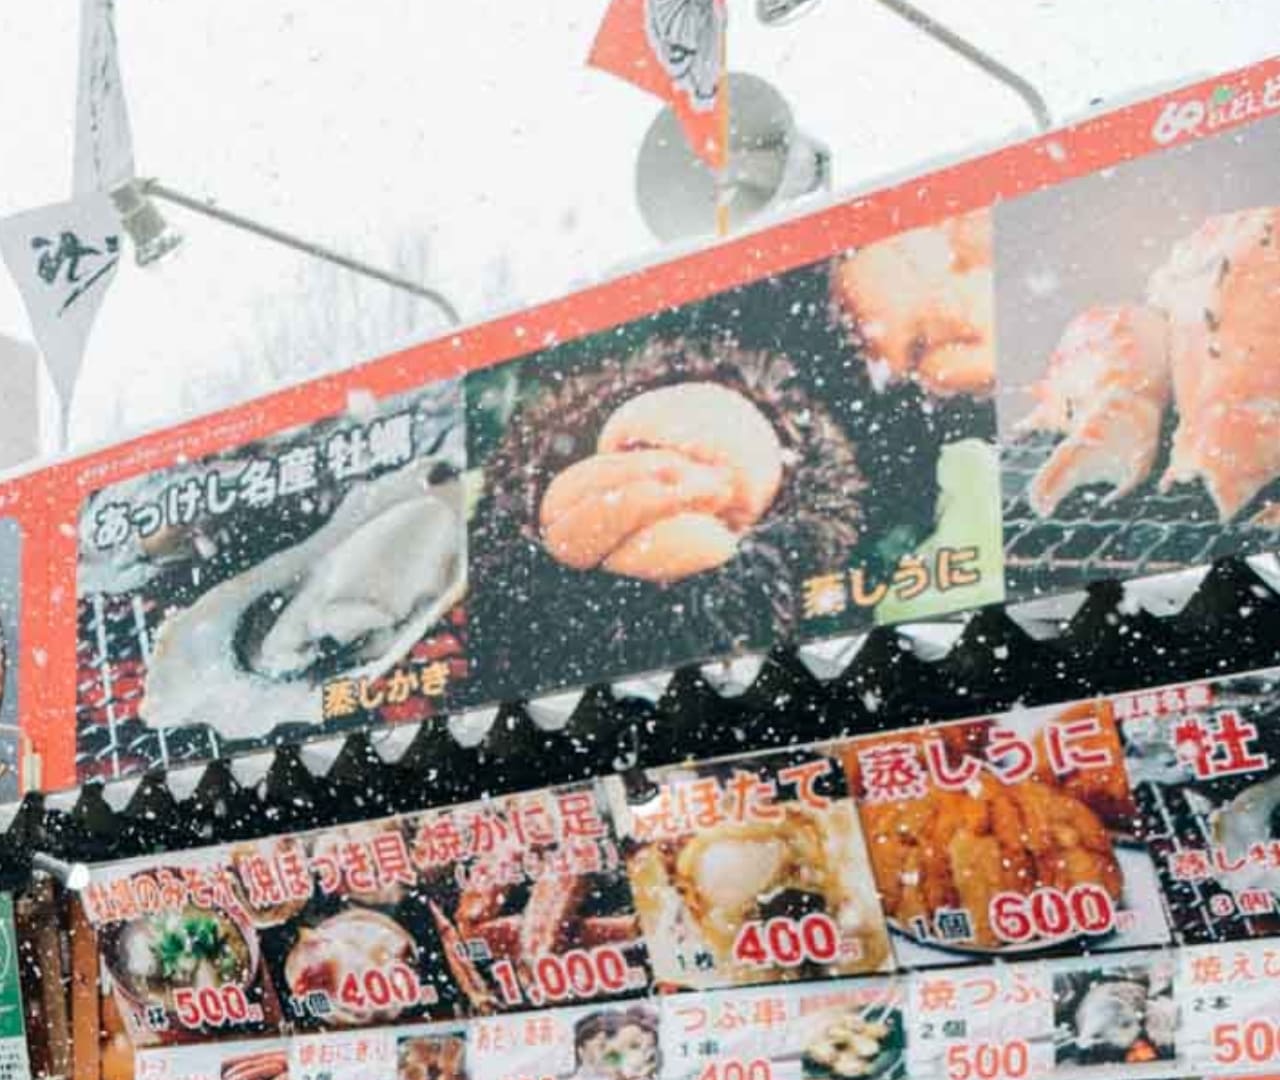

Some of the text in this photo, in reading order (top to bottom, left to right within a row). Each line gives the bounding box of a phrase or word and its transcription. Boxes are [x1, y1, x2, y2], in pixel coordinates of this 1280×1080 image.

[94, 444, 320, 550] あっけし名産
[802, 546, 981, 618] 蒸しうに
[324, 662, 451, 718] 蒸しかき
[858, 715, 1112, 798] 蒸しうに
